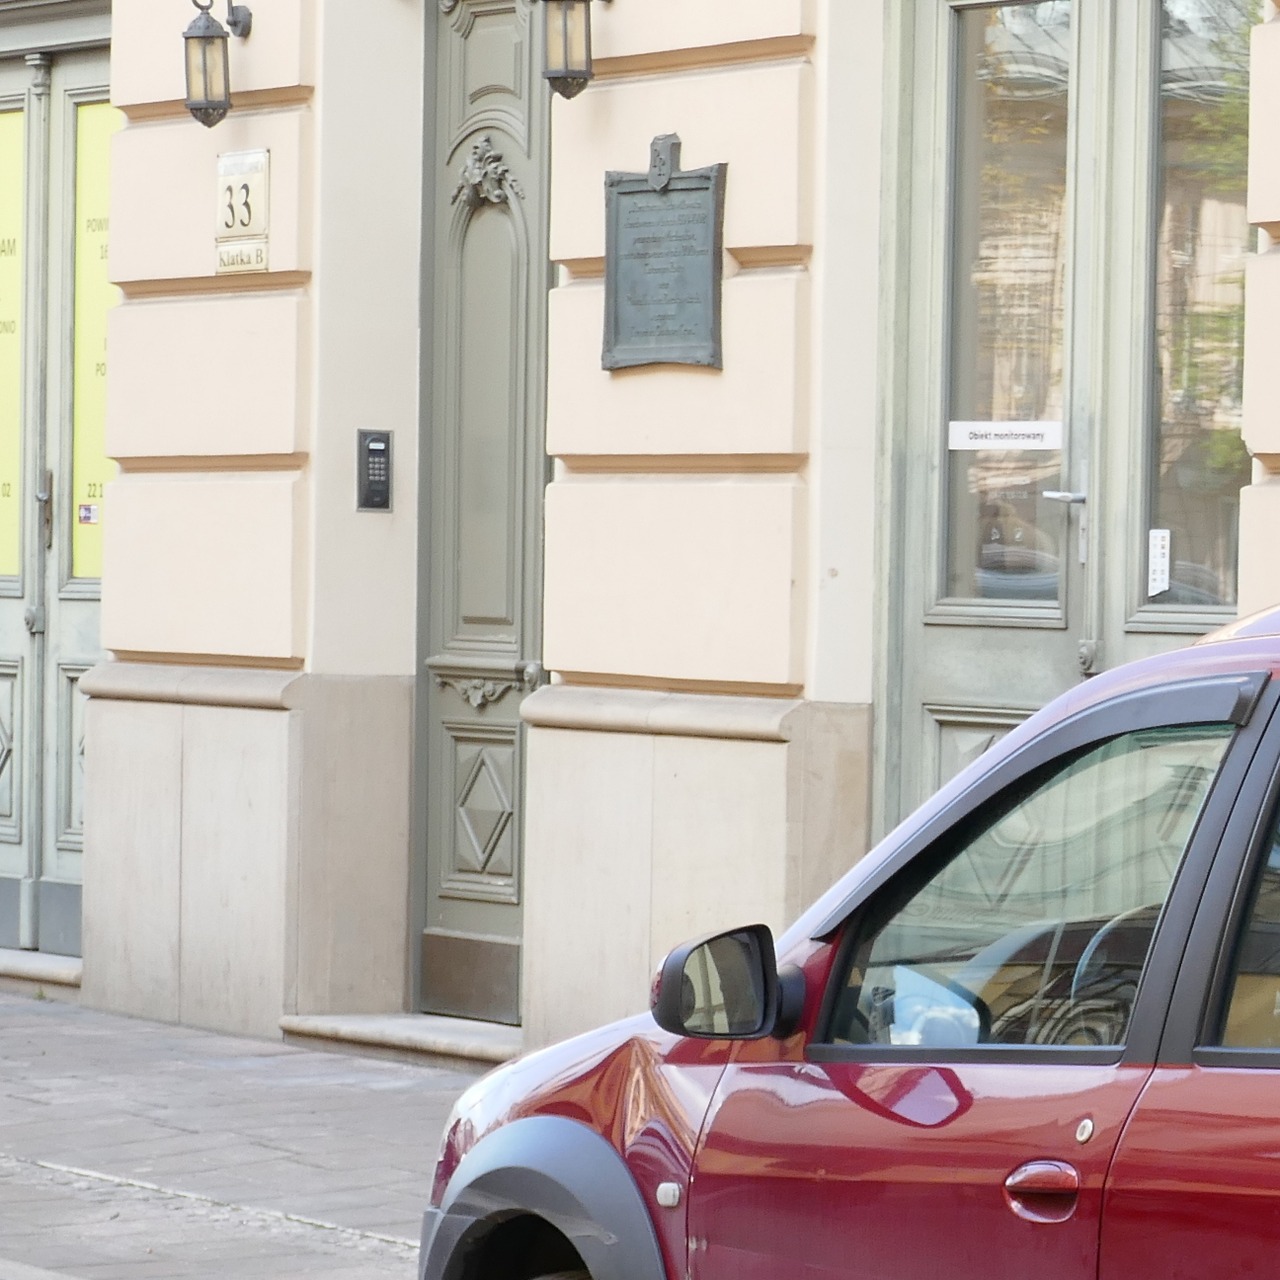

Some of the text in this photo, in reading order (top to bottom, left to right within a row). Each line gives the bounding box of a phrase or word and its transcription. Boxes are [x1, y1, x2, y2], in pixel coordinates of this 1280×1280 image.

[224, 183, 252, 229] 33
[219, 248, 264, 267] Klatka B
[968, 430, 1045, 443] Obiekt monitorowany
